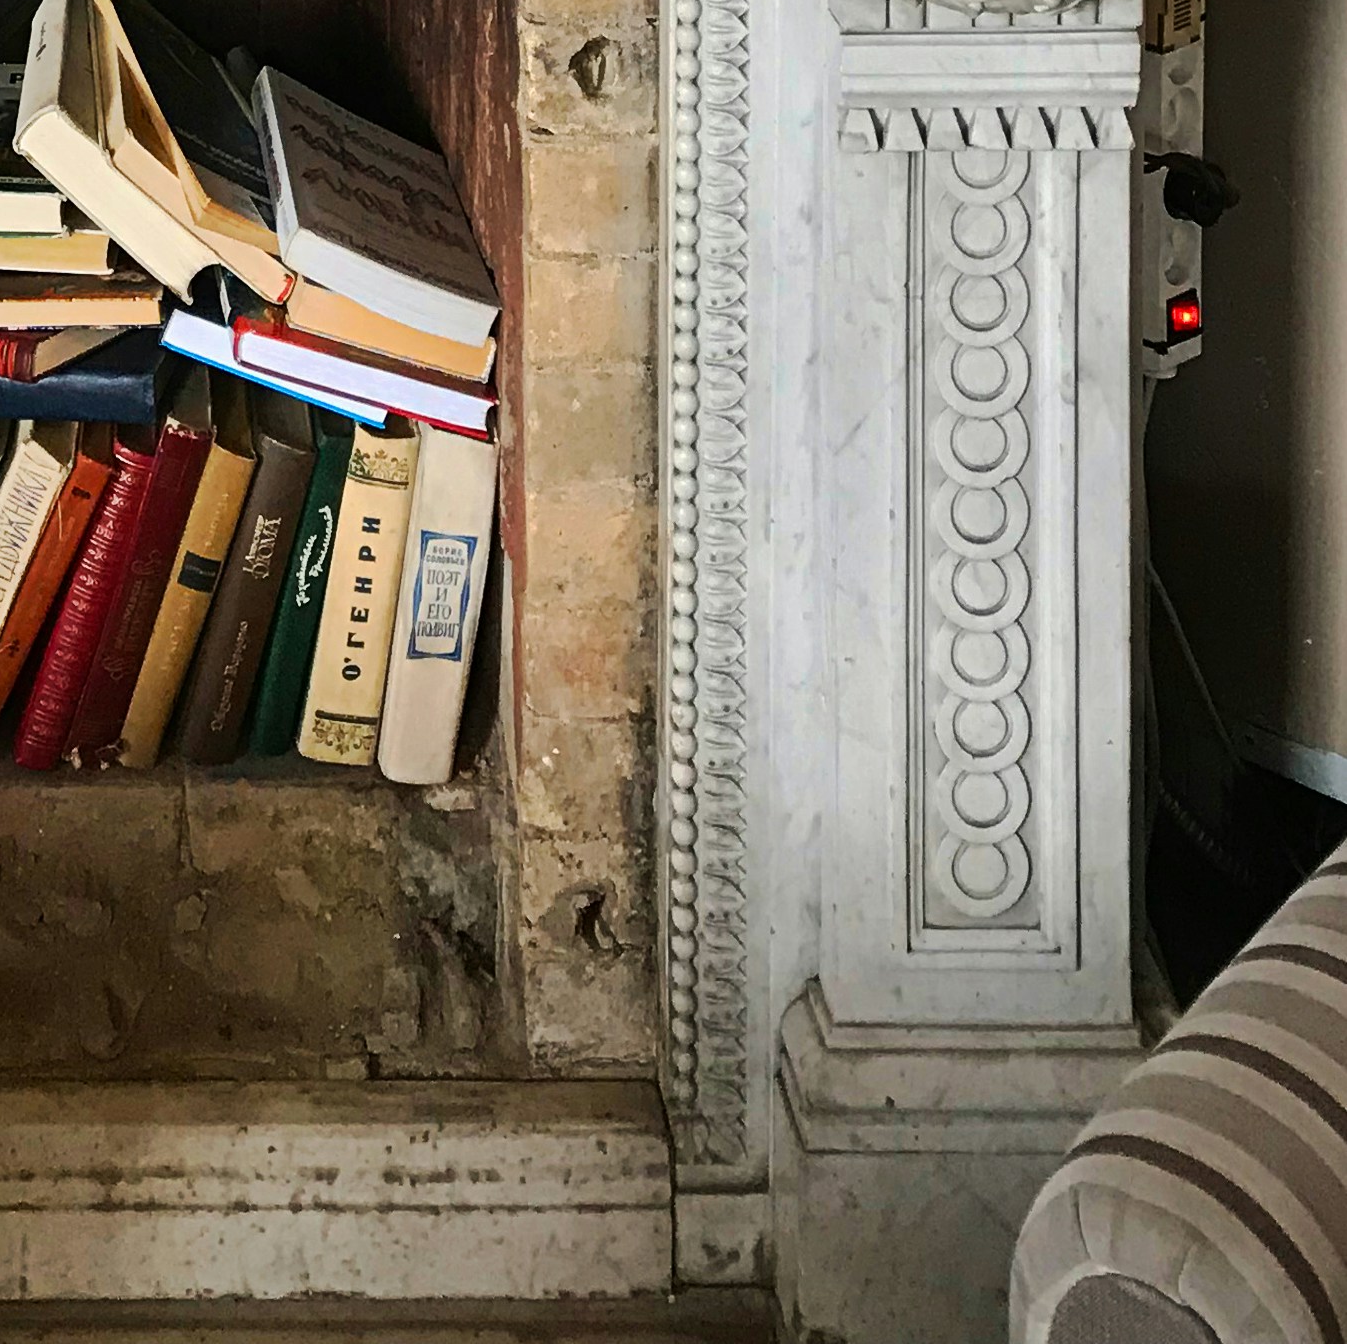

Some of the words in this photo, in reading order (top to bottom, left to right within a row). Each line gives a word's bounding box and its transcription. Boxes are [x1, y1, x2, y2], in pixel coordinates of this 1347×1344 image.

[426, 569, 462, 586] ПОЭТ
[436, 587, 449, 602] И
[427, 603, 453, 620] ЕГО
[416, 620, 461, 639] ПОДВИГ
